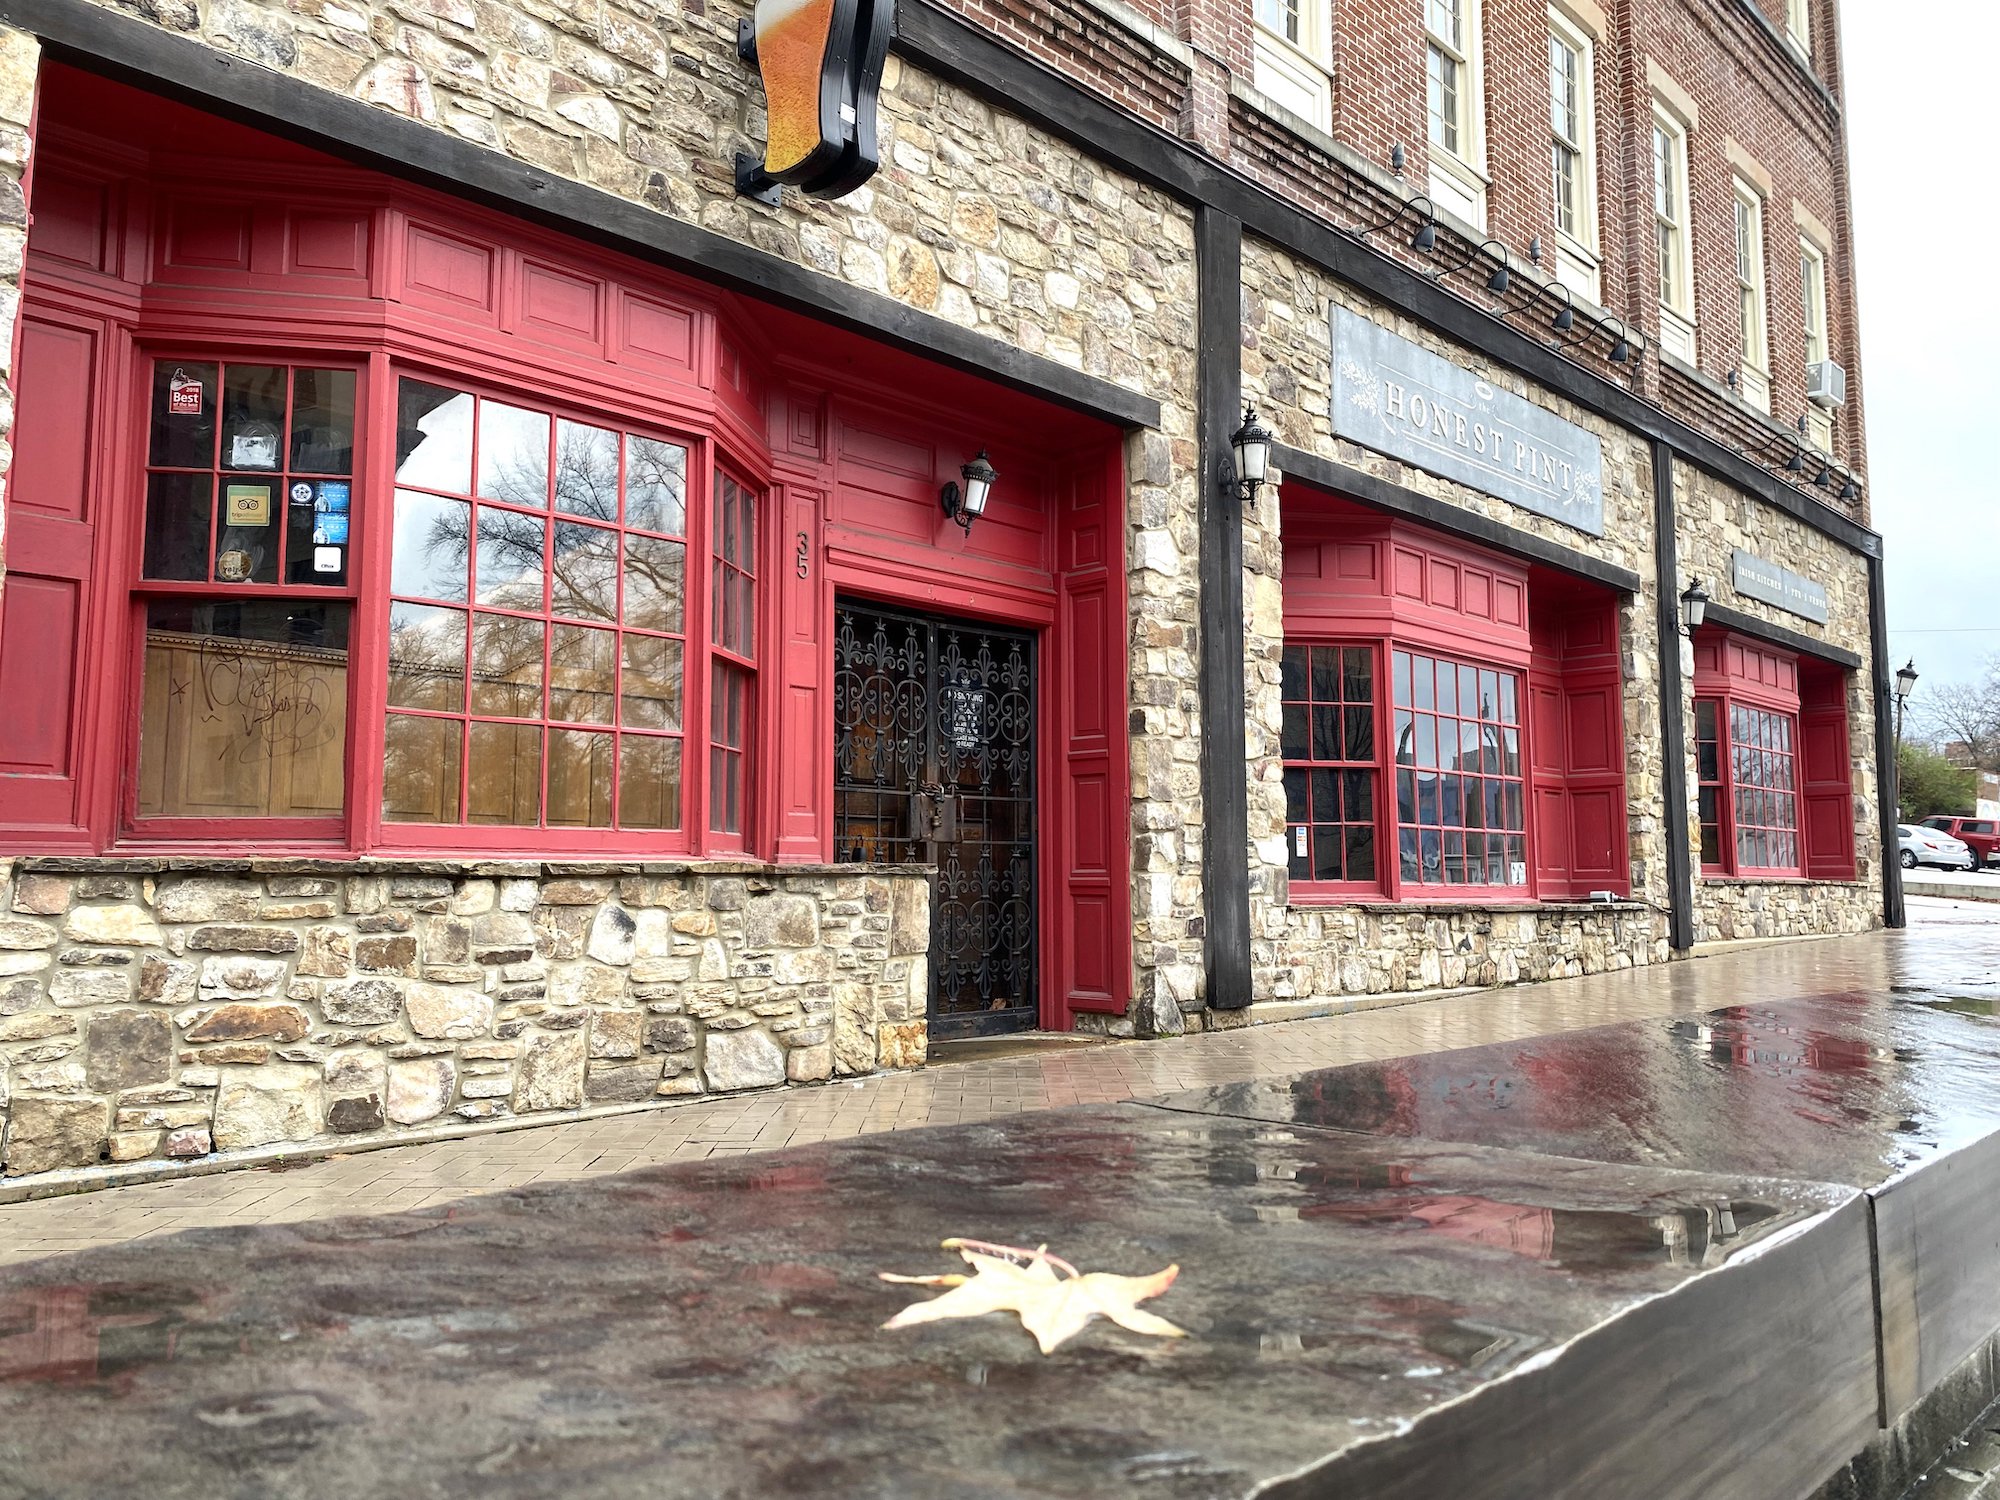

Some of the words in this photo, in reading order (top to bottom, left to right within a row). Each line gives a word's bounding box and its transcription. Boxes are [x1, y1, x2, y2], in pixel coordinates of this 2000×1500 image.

[173, 391, 199, 404] Best
[1385, 381, 1504, 462] HONEST
[1513, 440, 1572, 491] PINT
[797, 531, 809, 580] 35
[1738, 565, 1755, 581] IRISH
[1757, 574, 1782, 591] KITCHEN
